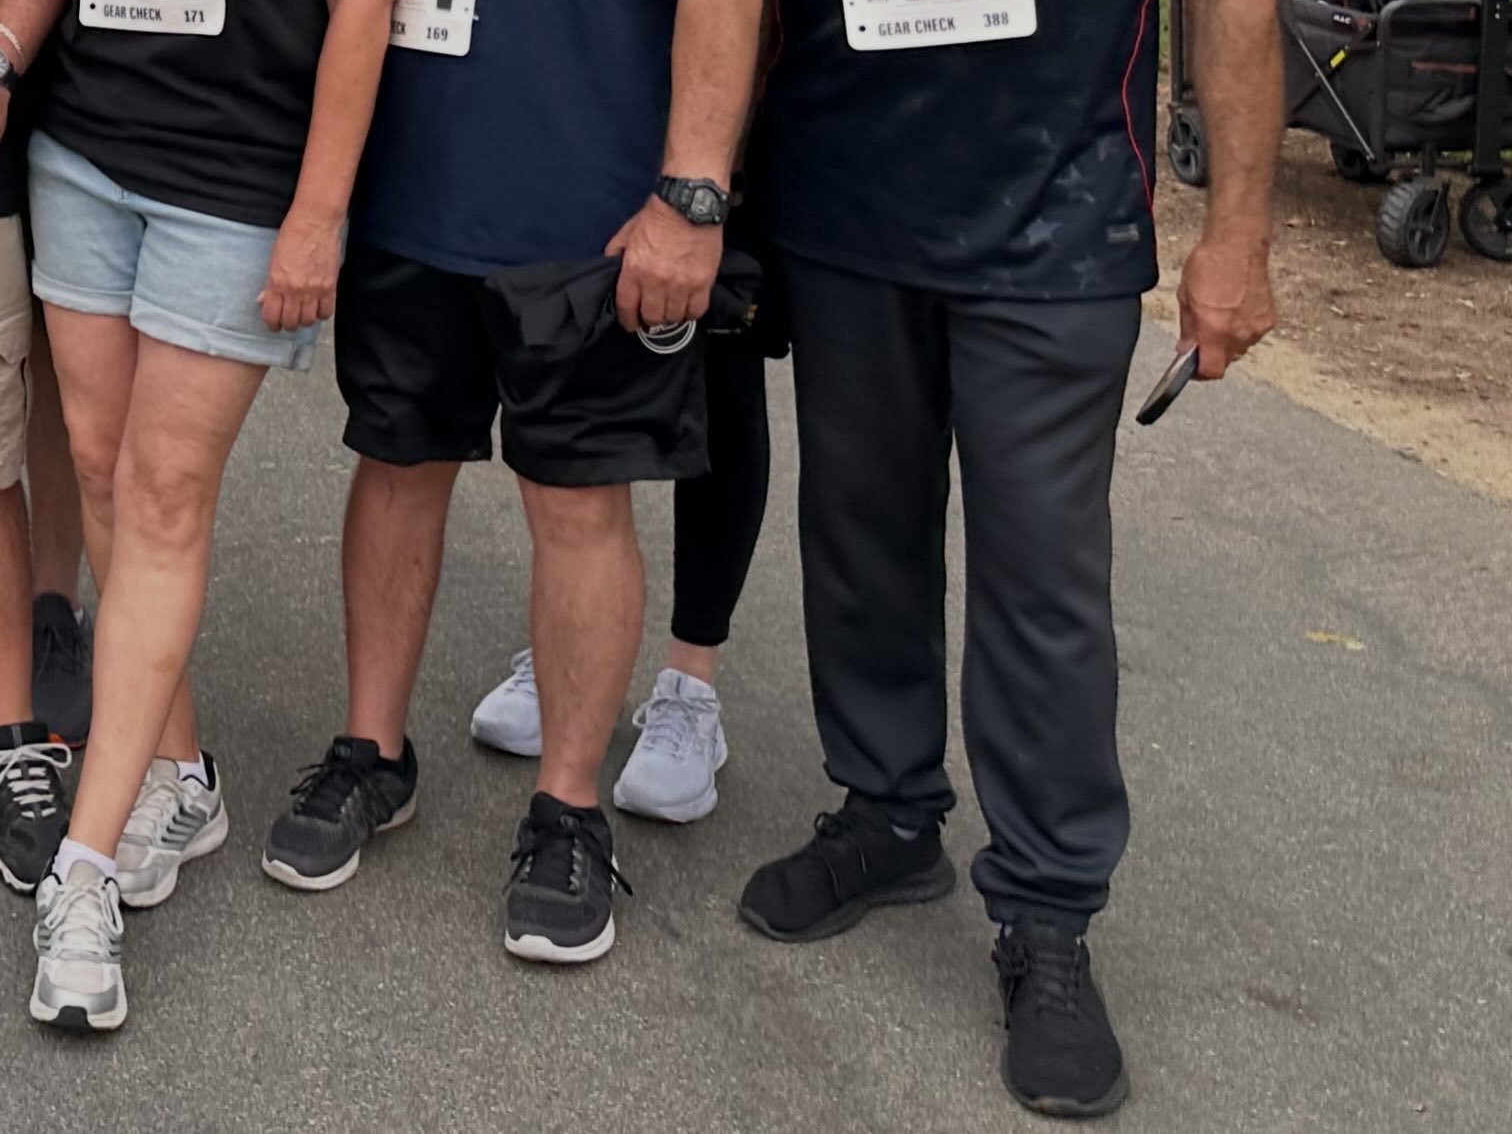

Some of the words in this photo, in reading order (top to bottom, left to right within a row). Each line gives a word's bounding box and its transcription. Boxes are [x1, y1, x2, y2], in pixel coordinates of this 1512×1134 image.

[103, 4, 127, 19] GEAR
[130, 6, 162, 21] CHECK
[184, 10, 205, 23] 171
[426, 26, 448, 42] 169
[878, 21, 911, 36] GEAR
[915, 17, 955, 34] CHECK
[983, 13, 1009, 28] 388
